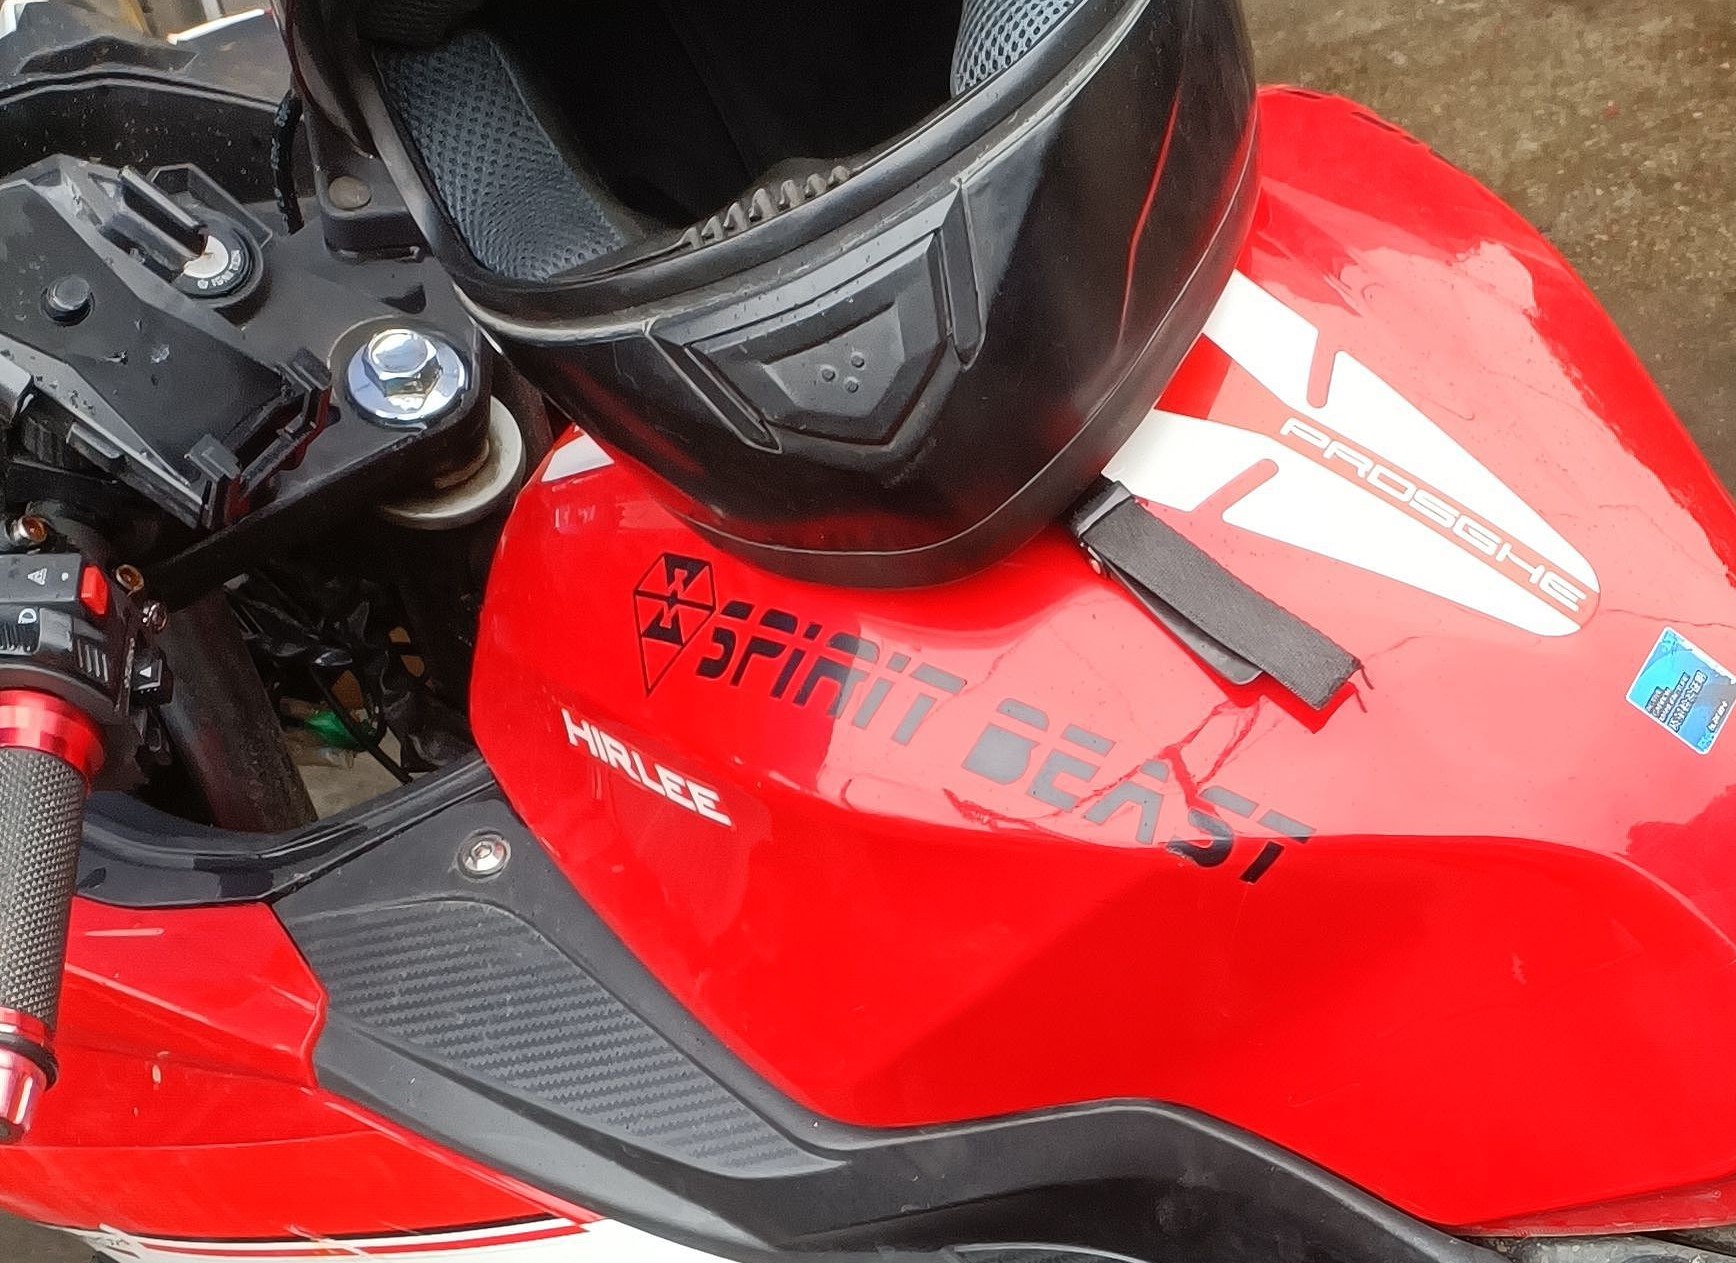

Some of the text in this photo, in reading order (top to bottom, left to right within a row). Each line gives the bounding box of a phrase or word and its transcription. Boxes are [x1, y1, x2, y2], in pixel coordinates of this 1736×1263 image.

[1279, 417, 1587, 613] PROSGHE
[560, 707, 732, 827] HIRLEE
[962, 698, 1317, 885] BEAST
